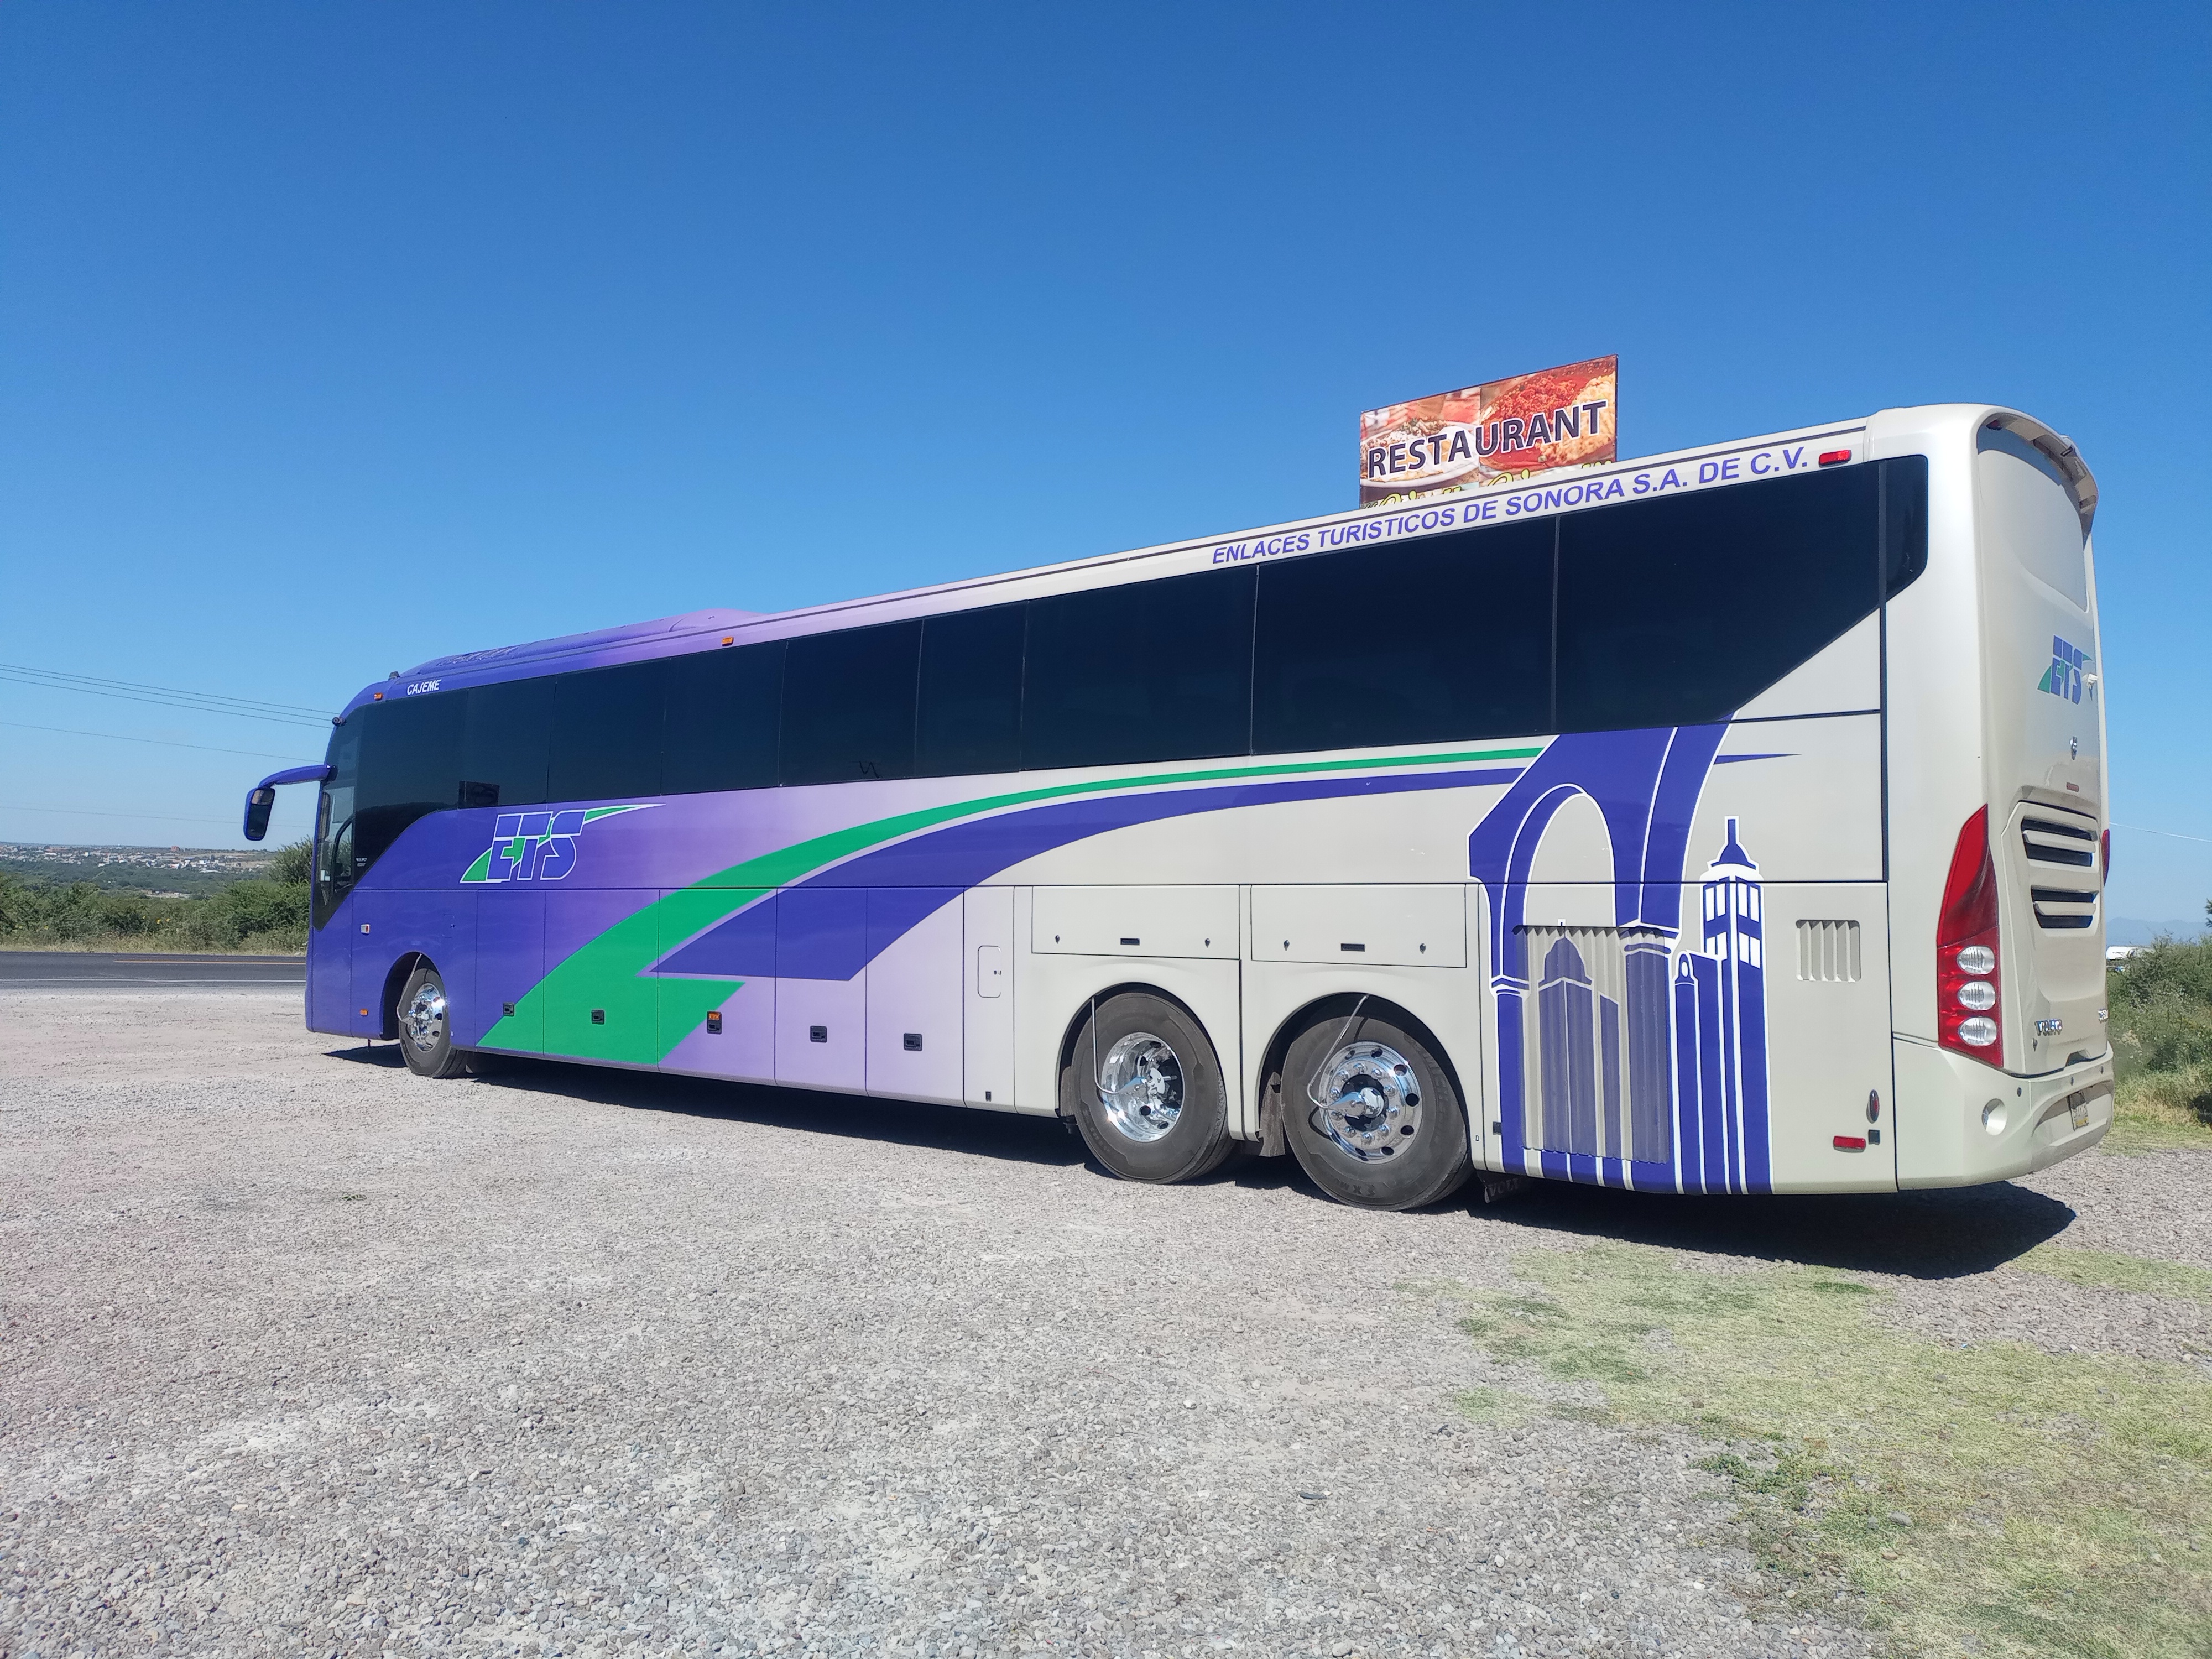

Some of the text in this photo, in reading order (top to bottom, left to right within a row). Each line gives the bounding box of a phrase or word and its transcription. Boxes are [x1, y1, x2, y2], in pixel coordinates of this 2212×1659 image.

[1368, 400, 1607, 479] RESTAURANT
[1212, 533, 1310, 564] ENLACES
[1317, 507, 1456, 548] TURISTICOS
[1463, 499, 1498, 523] DE
[1505, 479, 1625, 515] SONORA
[1632, 468, 1688, 494] S.A.
[1699, 458, 1740, 483] DE
[1750, 447, 1808, 474] C.V.
[406, 679, 442, 695] CAJEME
[2049, 634, 2083, 705] ETS
[485, 810, 586, 881] ETS
